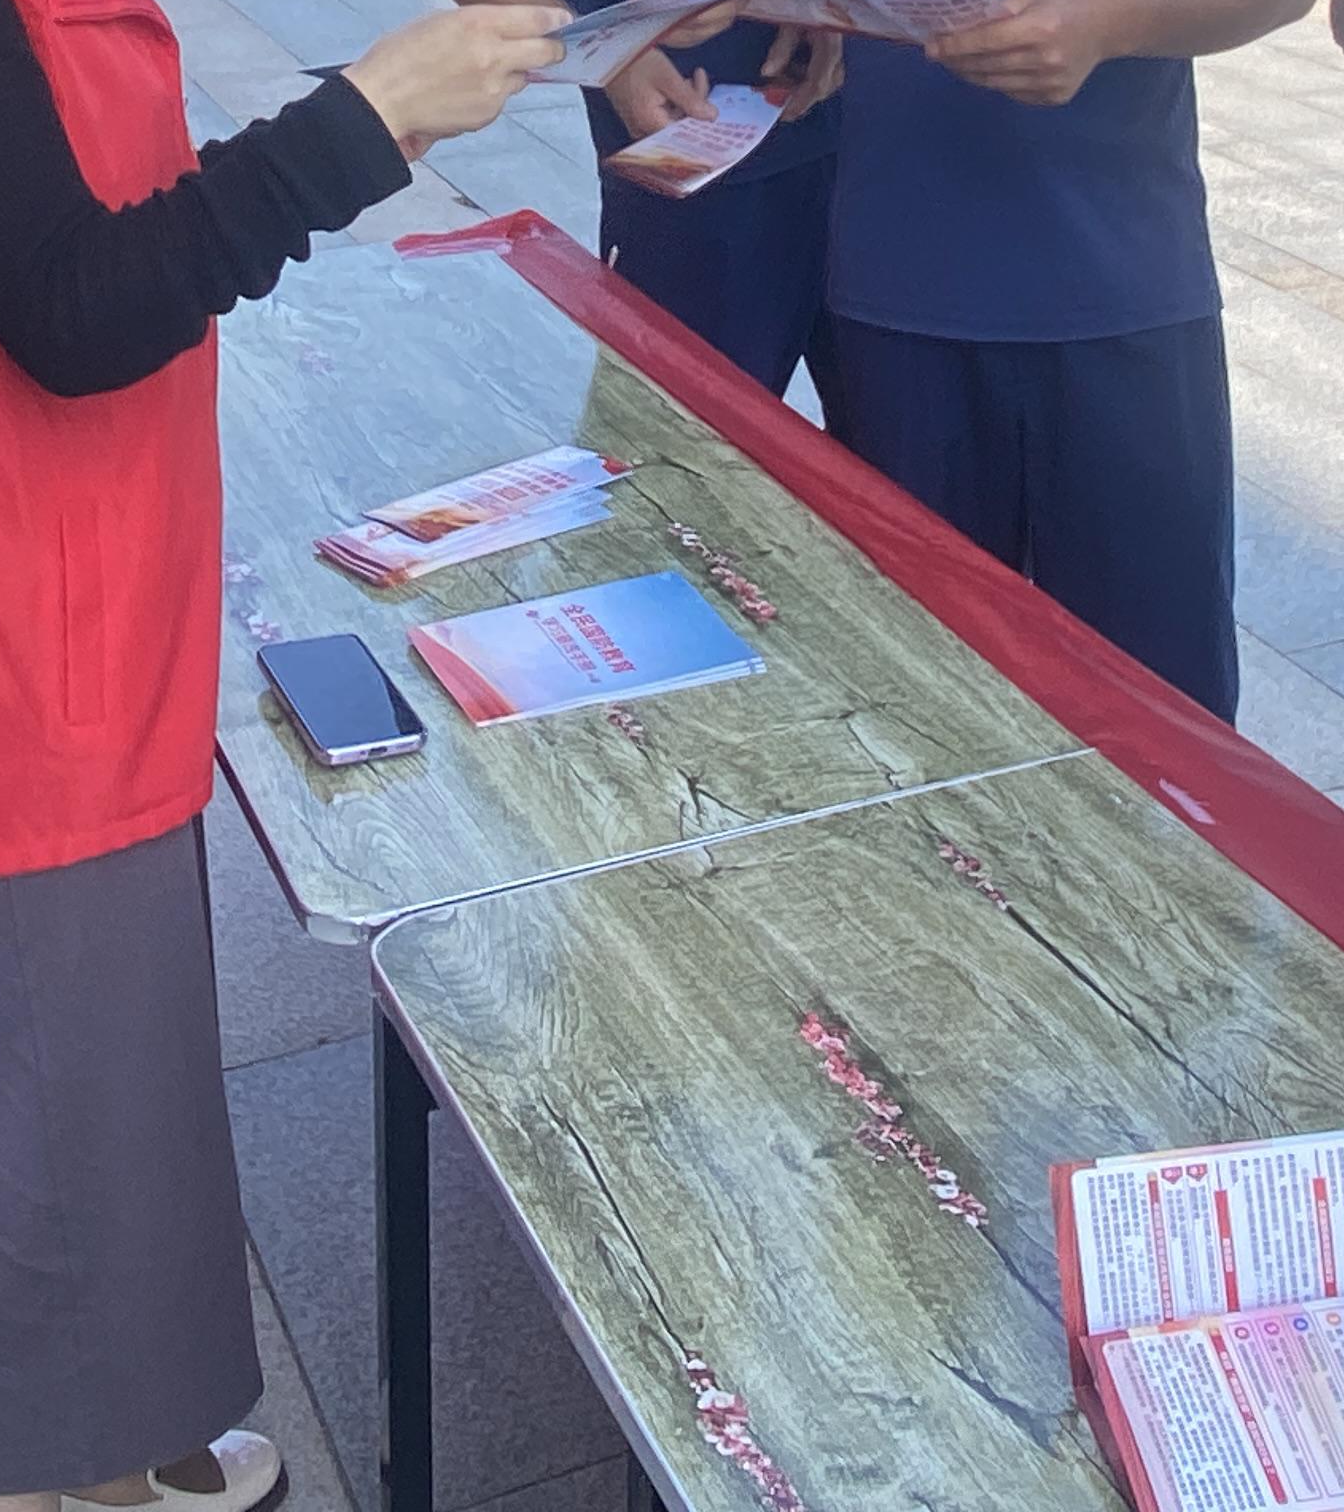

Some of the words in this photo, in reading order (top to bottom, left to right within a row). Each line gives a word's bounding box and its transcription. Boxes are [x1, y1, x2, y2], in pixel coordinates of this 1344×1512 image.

[560, 603, 637, 674] 全民国防教育
